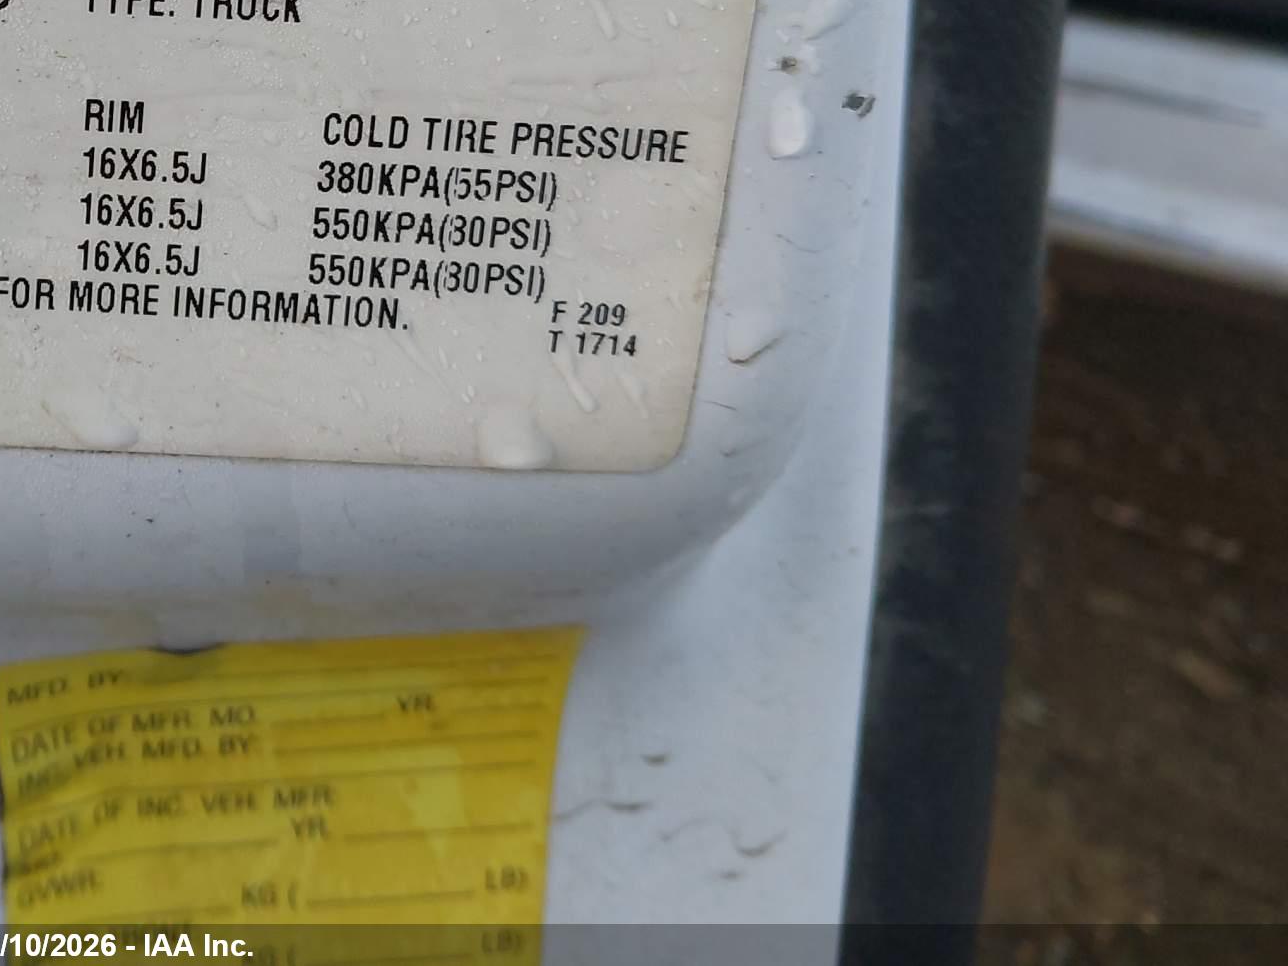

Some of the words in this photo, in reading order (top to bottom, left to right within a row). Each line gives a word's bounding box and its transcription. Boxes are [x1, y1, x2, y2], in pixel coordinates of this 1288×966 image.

[84, 98, 145, 135] RIM
[323, 112, 410, 150] COLD
[422, 117, 499, 155] TIRE
[510, 122, 690, 164] PRESSURE
[82, 146, 208, 185] 16X6.5J
[316, 159, 558, 212] 380KPA(55PSI)
[79, 192, 203, 231] 16X6.5J
[77, 238, 201, 277] 16X6.5J
[68, 280, 160, 316] MORE
[173, 285, 408, 331] INFORMATION.
[551, 300, 568, 324] F
[577, 301, 626, 327] 209
[548, 329, 564, 354] T
[575, 331, 637, 357] 1714
[11, 717, 75, 764] DATE
[88, 713, 121, 735] OF
[19, 817, 79, 852] DATE
[94, 797, 123, 825] OF
